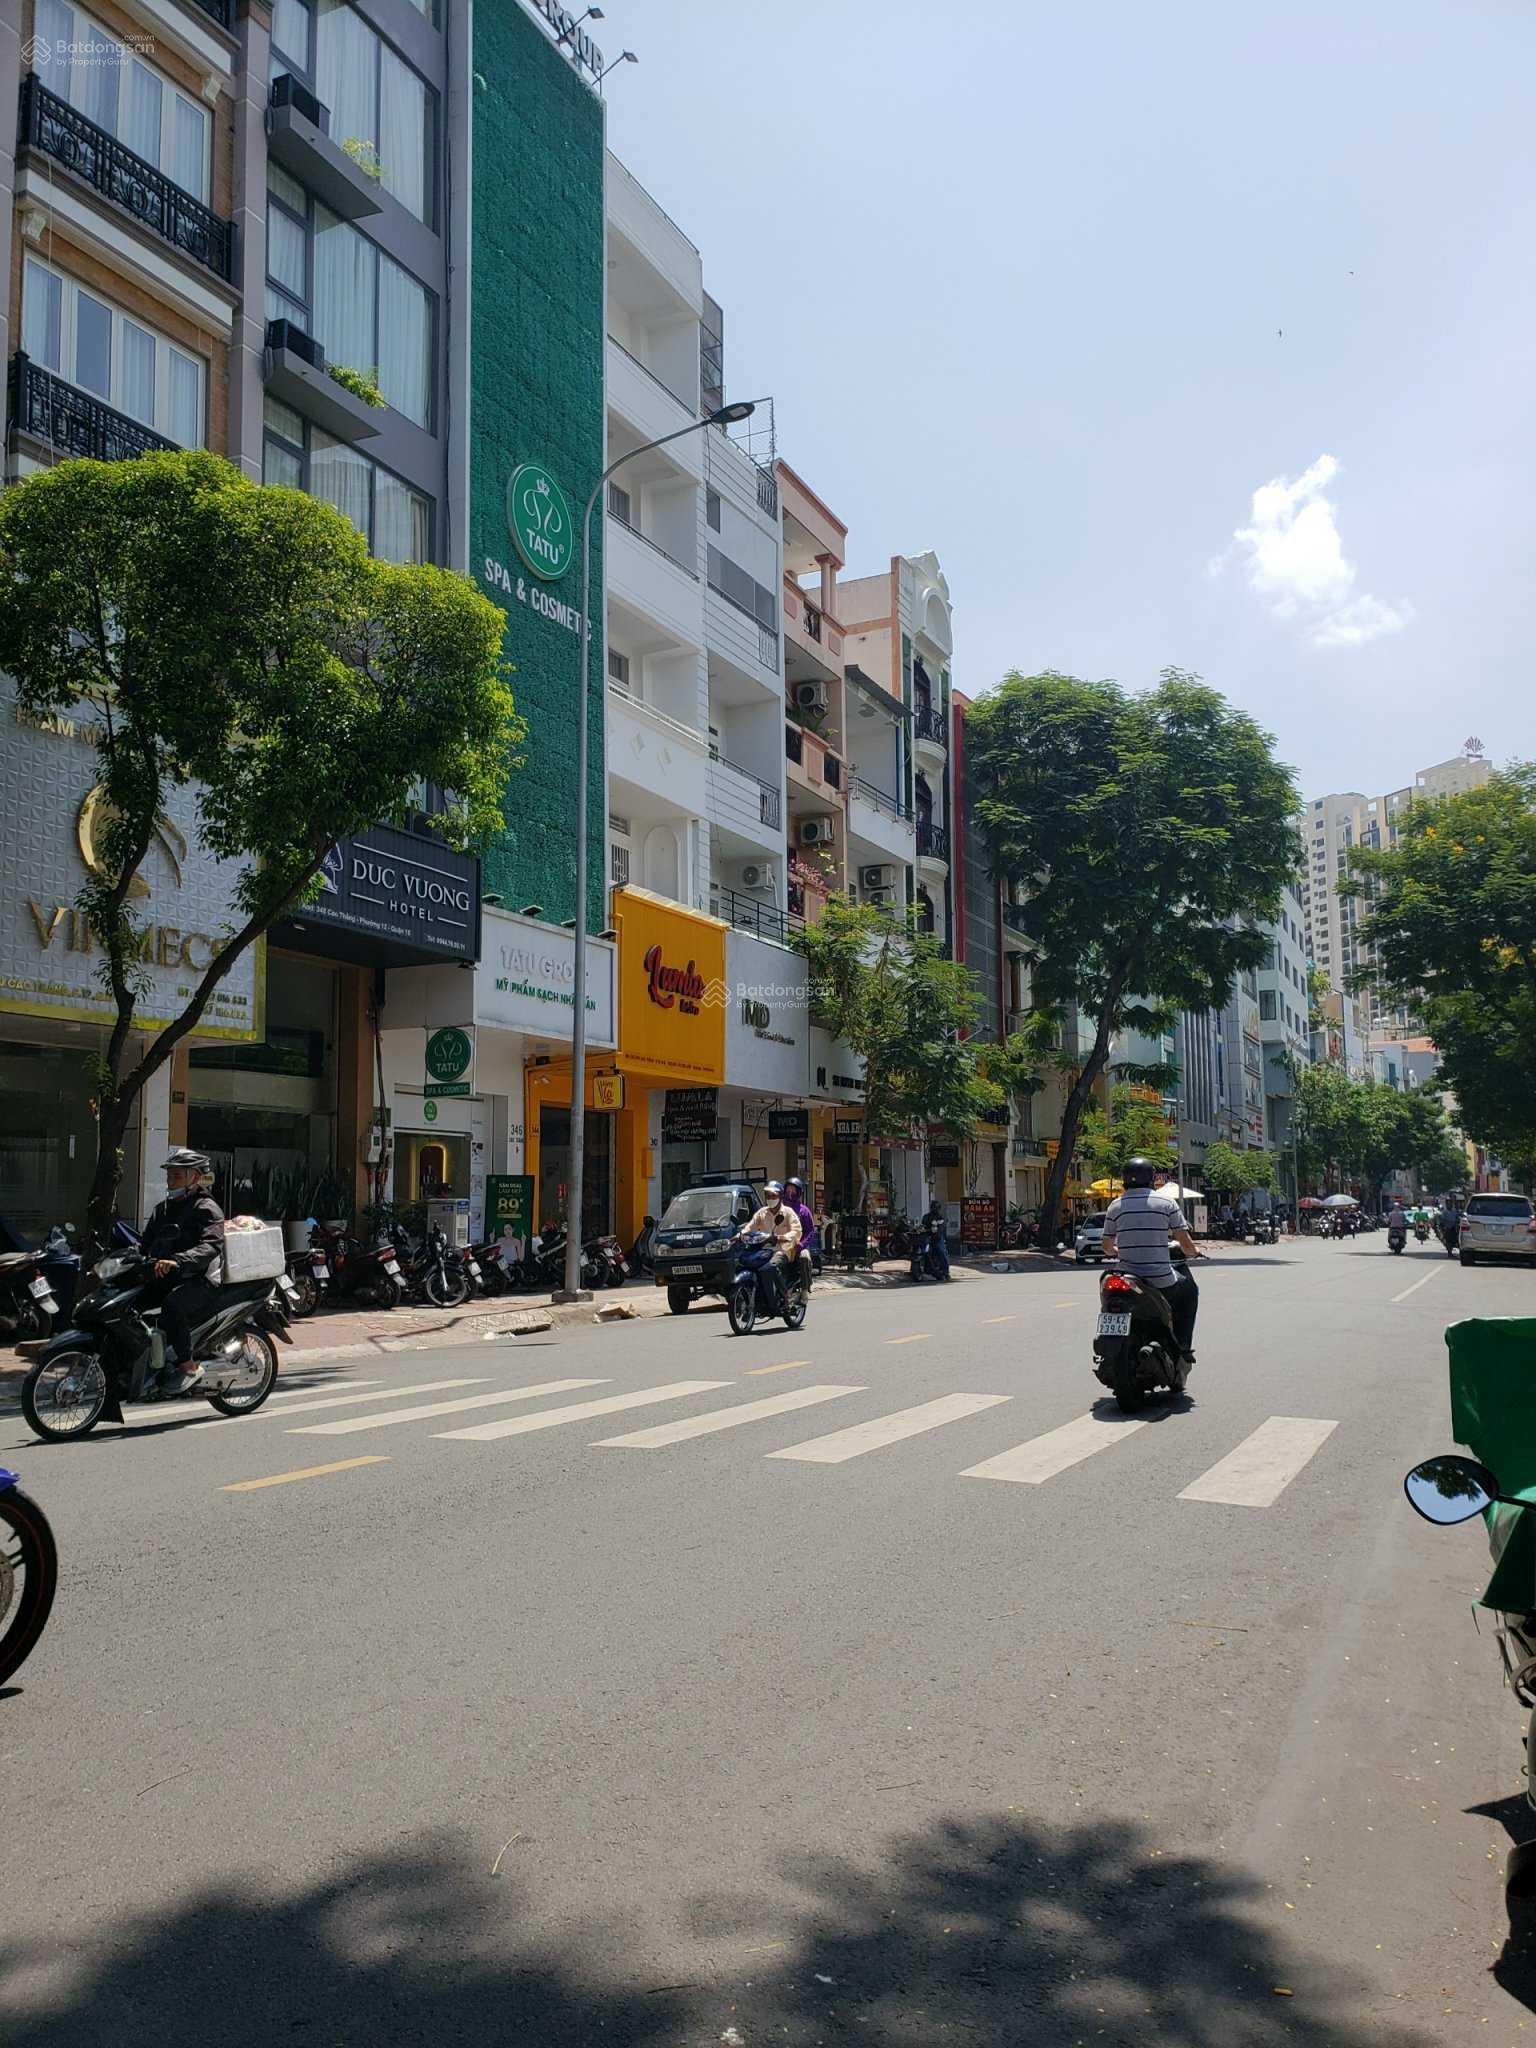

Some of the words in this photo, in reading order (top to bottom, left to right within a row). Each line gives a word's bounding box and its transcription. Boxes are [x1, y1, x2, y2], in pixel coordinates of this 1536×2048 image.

[526, 528, 560, 565] TATU
[484, 557, 512, 594] SPA
[516, 577, 527, 603] &
[531, 587, 592, 642] COSMETC
[353, 858, 396, 889] DUC
[404, 873, 470, 911] VUONG
[390, 899, 434, 921] HOTEL
[496, 977, 508, 992] MỸ
[436, 1062, 459, 1073] TATU
